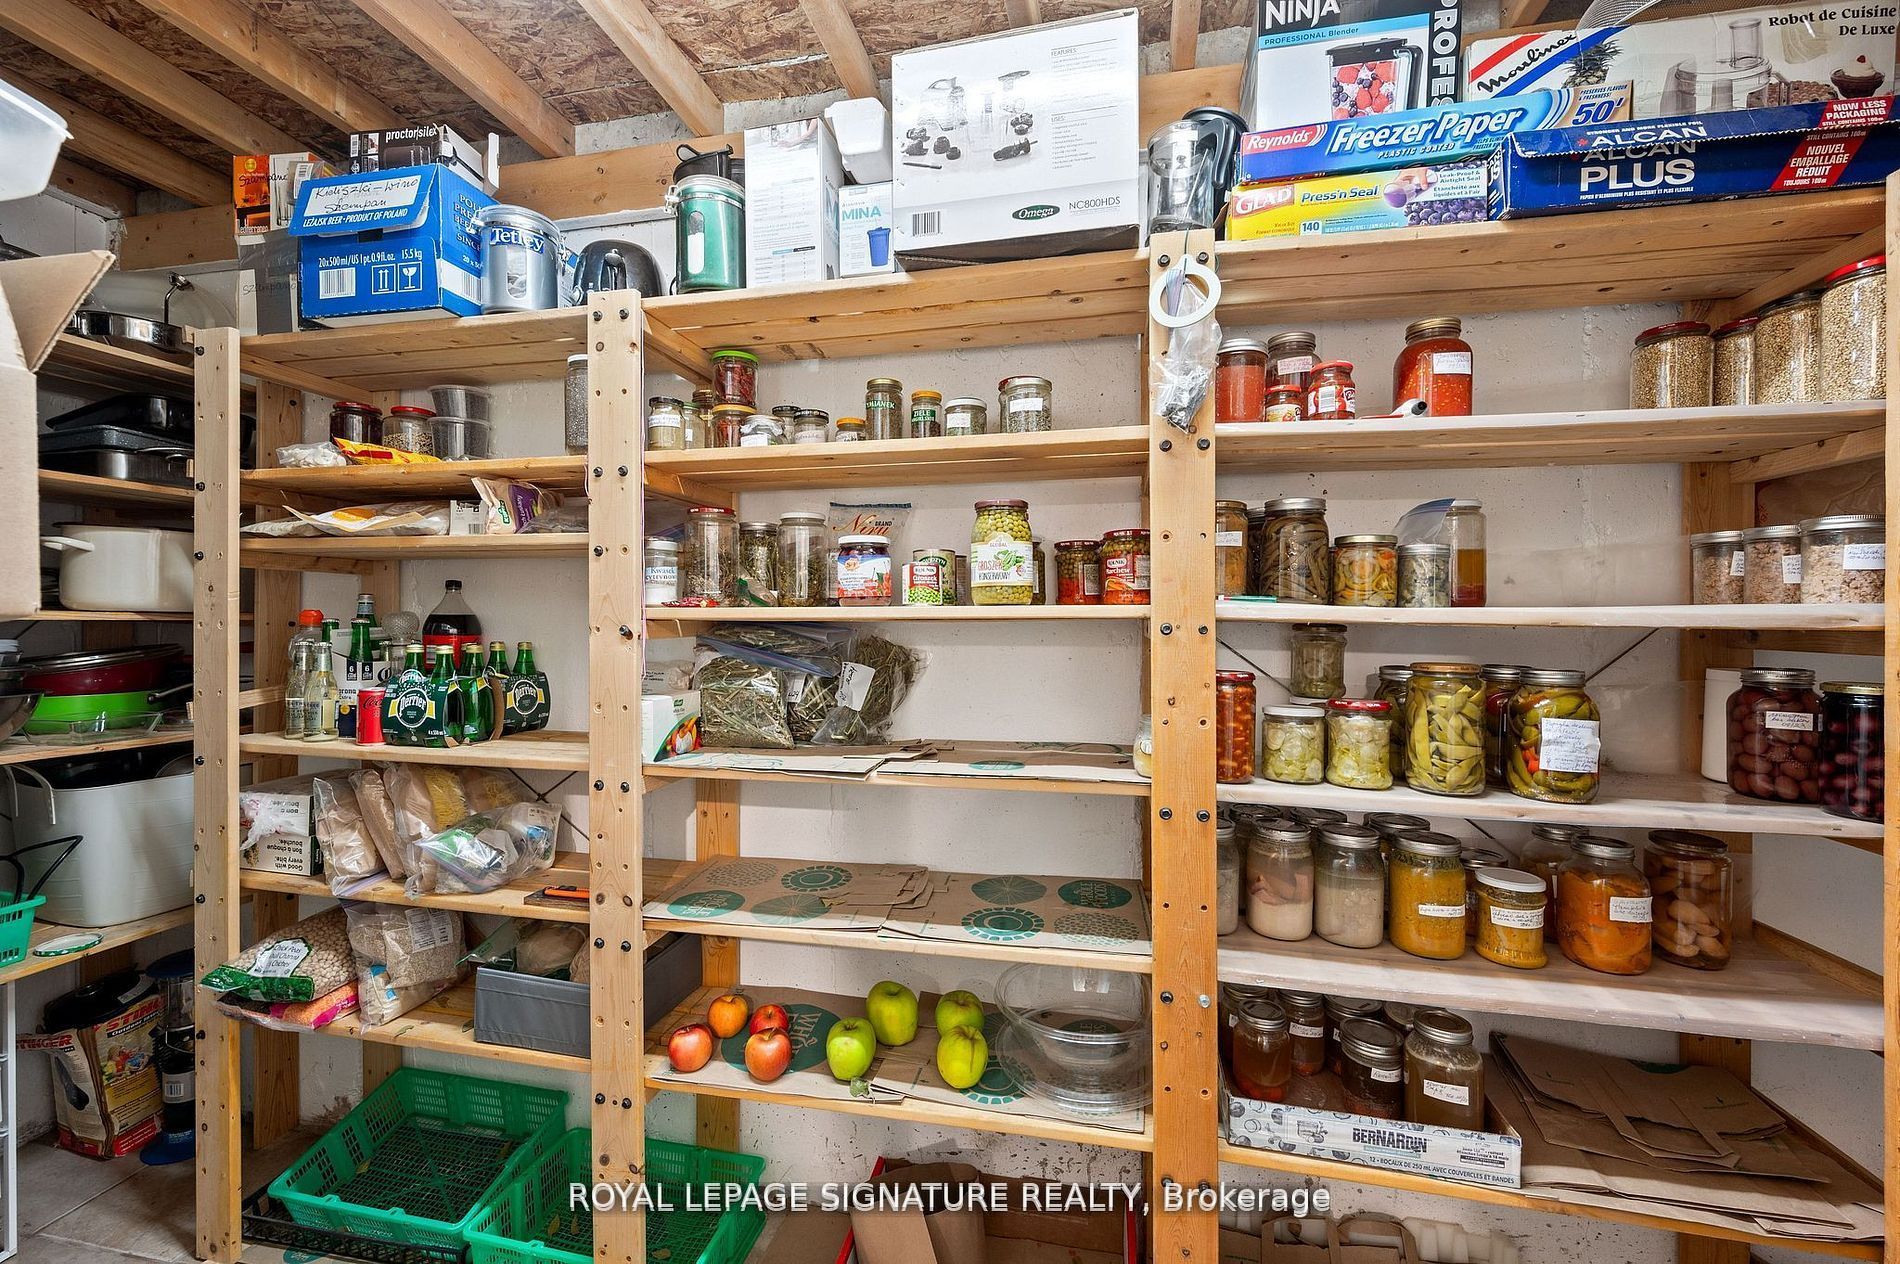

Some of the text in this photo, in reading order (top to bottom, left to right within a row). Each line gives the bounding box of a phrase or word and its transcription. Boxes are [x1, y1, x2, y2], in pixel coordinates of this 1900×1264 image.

[1265, 0, 1341, 29] NINJA
[1768, 5, 1897, 27] Robot de Cuisine
[1264, 27, 1359, 46] PROFESSIONAL Blender
[1838, 22, 1896, 36] De Luxe
[1476, 33, 1578, 94] Moulinex
[1607, 84, 1628, 92] FLAVOUR
[1826, 107, 1886, 120] PACKAGING
[1832, 99, 1887, 112] NOW LESS
[1837, 118, 1866, 126] CONTAINS
[1331, 110, 1522, 154] Freezer Paper
[1591, 126, 1708, 148] ALCAN
[1821, 131, 1849, 140] CONTAINS
[1247, 131, 1311, 151] Reynolds
[1806, 143, 1846, 155] NOUVEL
[1377, 142, 1456, 158] PLASTIC COATED
[1582, 141, 1696, 163] ALCAN
[1790, 153, 1850, 168] EMBALLAGE
[1580, 158, 1696, 192] PLUS
[1783, 179, 1811, 187] TOUJOURS
[1068, 196, 1121, 210] NC800HDS
[1235, 188, 1293, 217] GLAD
[1301, 189, 1347, 203] Press'n
[1348, 186, 1378, 198] Seal
[327, 214, 343, 227] BEER
[345, 211, 374, 223] PRODUCT
[374, 211, 383, 221] OF
[383, 207, 408, 220] POLAND
[842, 205, 882, 222] MINA
[1302, 222, 1320, 232] 140
[490, 228, 545, 252] Tetley
[414, 247, 423, 260] kg
[274, 862, 304, 872] Good with
[1352, 1127, 1428, 1153] BERNARDIN
[1380, 1157, 1403, 1168] BOCAUX
[1403, 1160, 1412, 1169] DE
[1412, 1162, 1423, 1171] 250
[1431, 1165, 1448, 1174] AVEC
[1447, 1167, 1483, 1181] COUVERCLES
[1483, 1173, 1491, 1181] ET
[1491, 1174, 1515, 1185] BANDES
